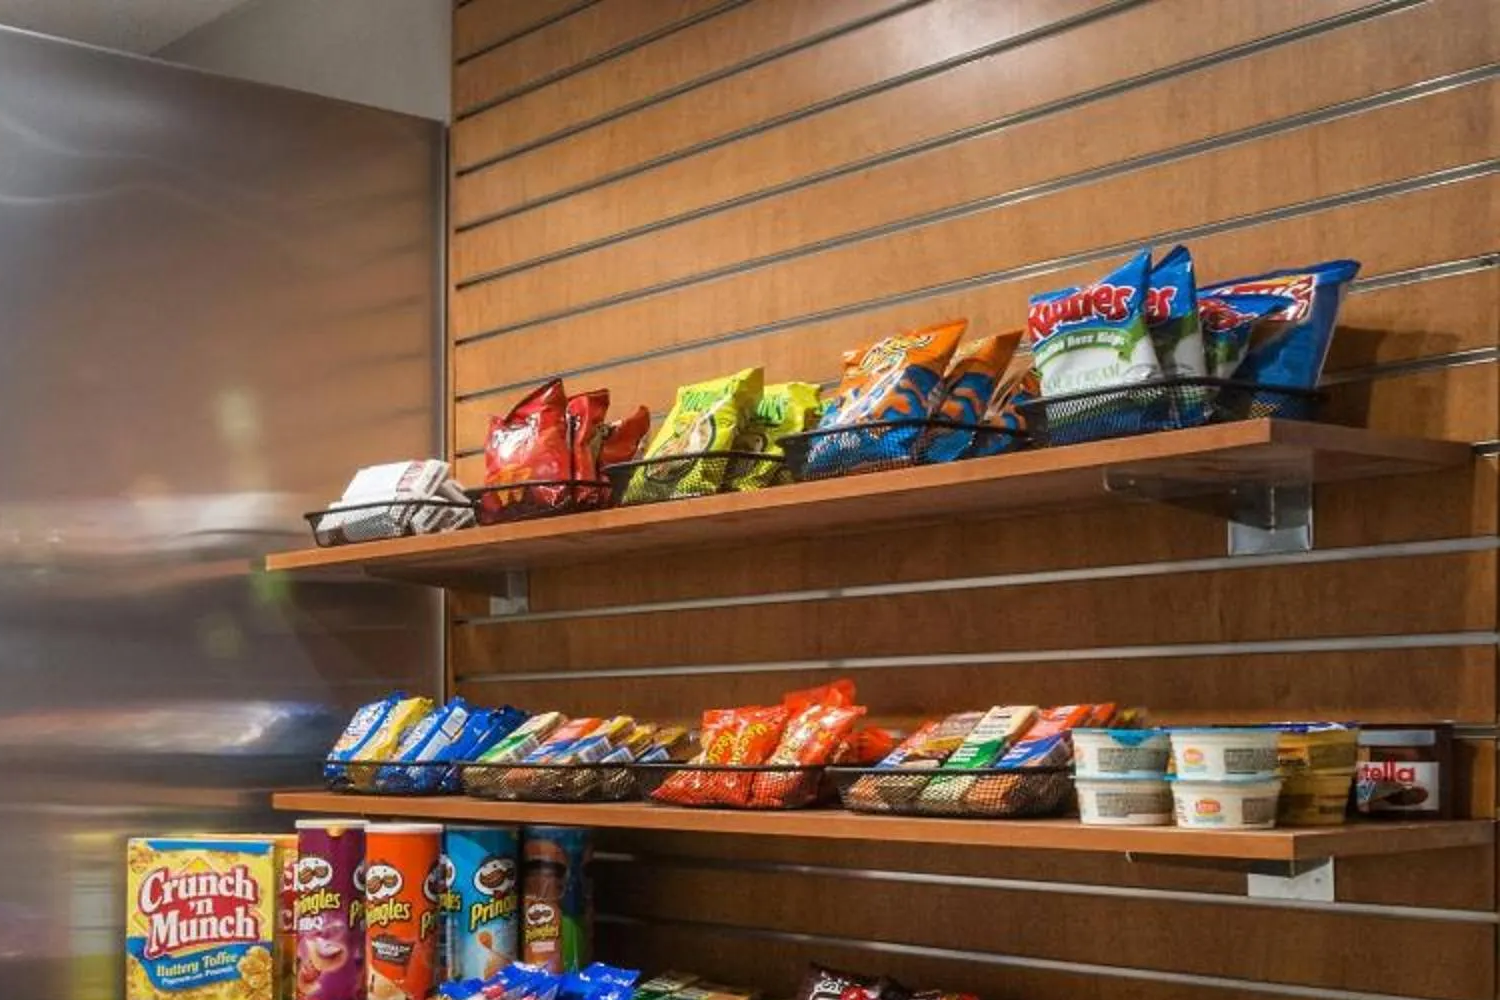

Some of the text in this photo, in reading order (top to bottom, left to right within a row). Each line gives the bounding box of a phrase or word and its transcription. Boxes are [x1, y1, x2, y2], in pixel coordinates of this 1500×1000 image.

[1360, 759, 1416, 782] tella
[141, 866, 255, 913] Crunch
[148, 906, 257, 953] Munch
